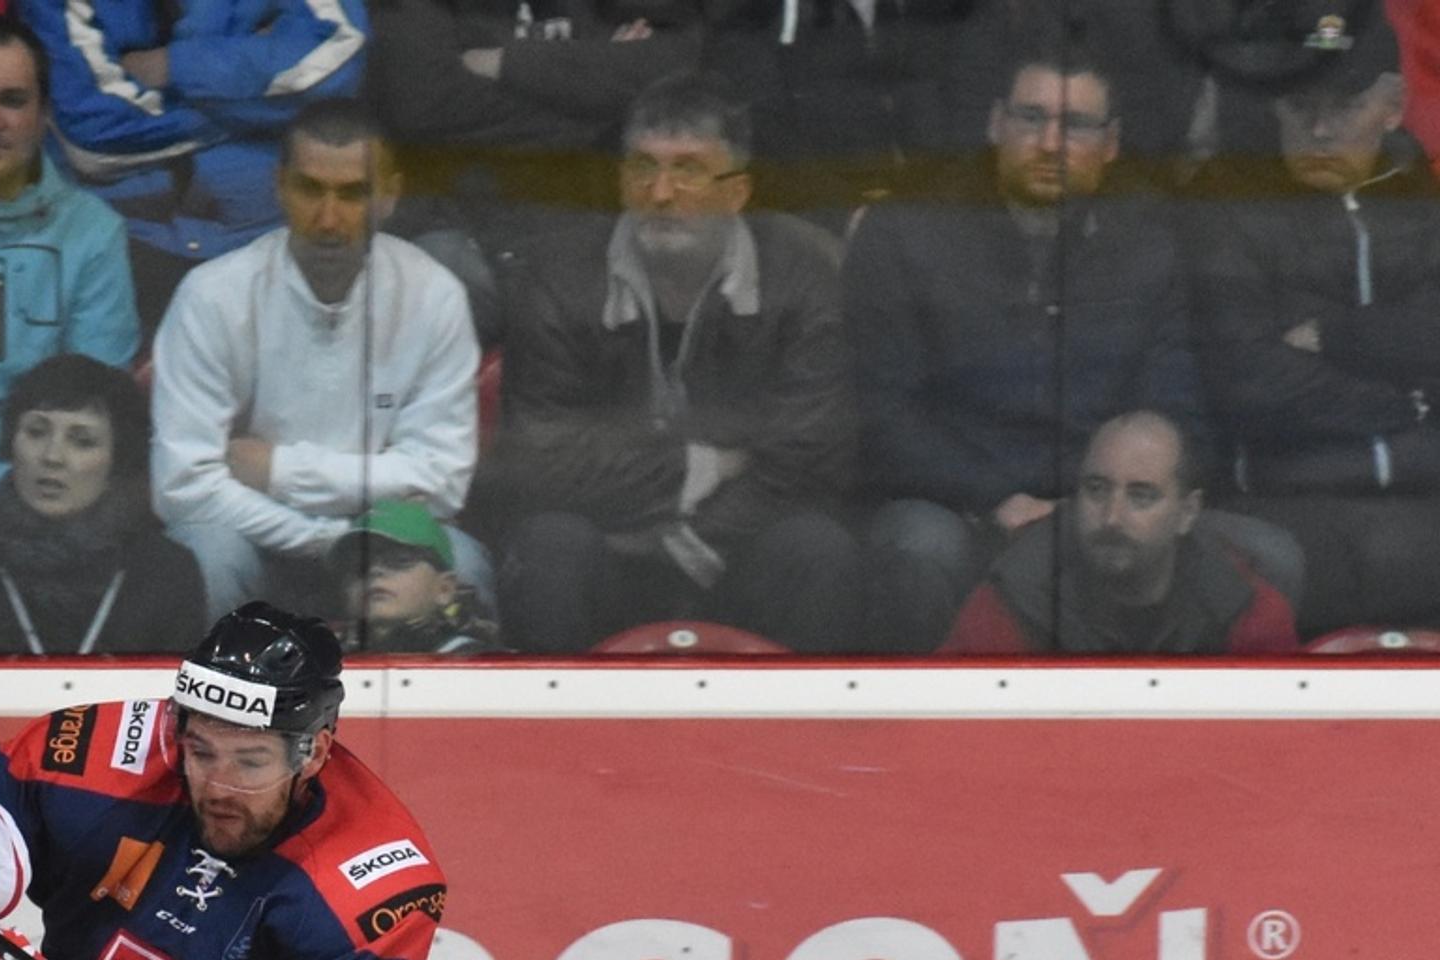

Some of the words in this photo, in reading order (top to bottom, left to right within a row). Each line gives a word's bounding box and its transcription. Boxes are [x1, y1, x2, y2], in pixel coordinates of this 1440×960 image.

[175, 670, 270, 717] ŠKODA
[121, 701, 152, 766] ŠKODA
[348, 847, 421, 881] ŠKODA
